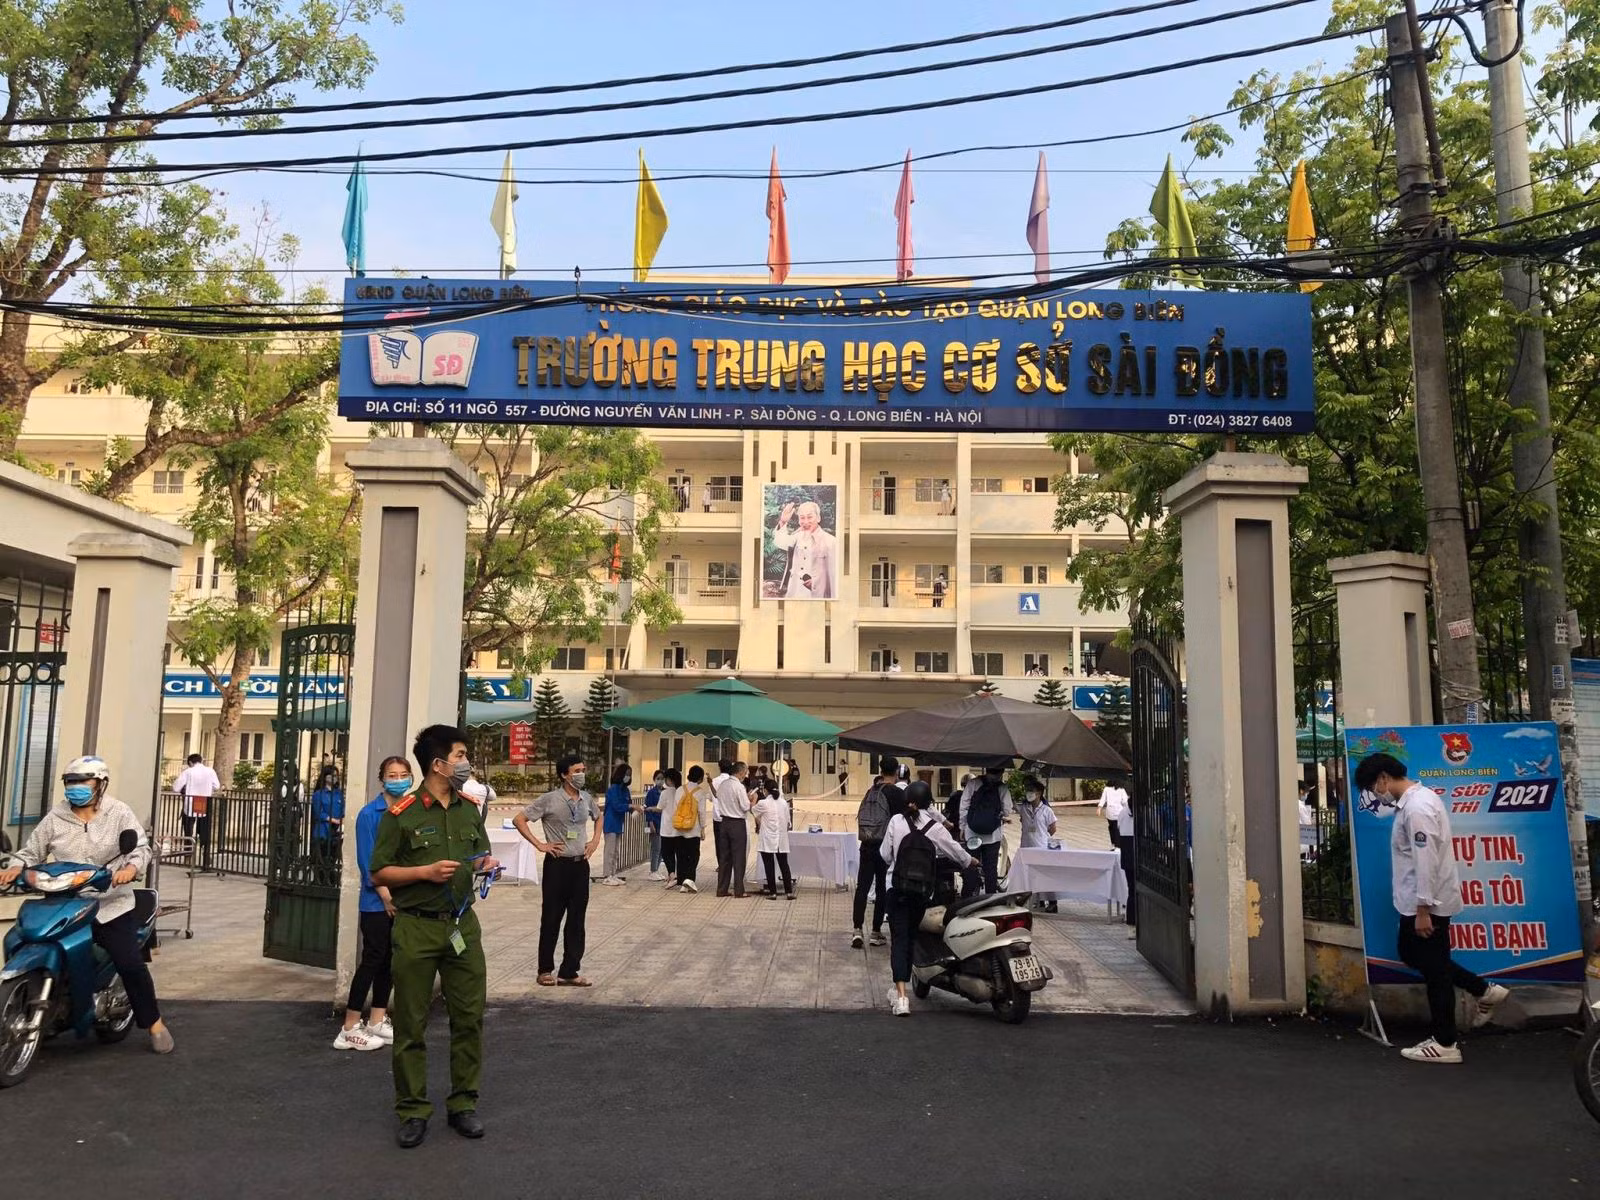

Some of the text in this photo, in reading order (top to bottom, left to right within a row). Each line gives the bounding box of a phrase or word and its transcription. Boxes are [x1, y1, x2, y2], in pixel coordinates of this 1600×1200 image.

[452, 286, 494, 300] LONG
[978, 295, 1049, 324] QUẬN
[1056, 300, 1125, 321] LONG
[1134, 298, 1185, 322] BIÊN
[512, 319, 1289, 402] TRƯỜNG TRUNG HỌC CƠ SỞ SÀI ĐỒNG
[366, 400, 389, 415] ĐỊA
[393, 399, 421, 413] CHỈ:
[424, 398, 446, 414] SỐ
[448, 403, 462, 415] 11
[466, 400, 498, 415] NGÕ
[505, 405, 528, 416] 557
[539, 402, 591, 417] ĐƯỜNG
[595, 402, 653, 418] NGUYỄN
[658, 406, 687, 419] VĂN
[690, 408, 722, 420] LINH
[734, 409, 745, 420] P.
[750, 405, 773, 420] SÀI
[776, 405, 817, 421] ĐỒNG
[890, 408, 923, 422] BIÊN
[934, 408, 953, 423] HÀ
[957, 409, 982, 425] NỘI
[1228, 415, 1258, 426] 3827
[1262, 416, 1293, 427] 6408
[1021, 595, 1038, 611] A
[1449, 768, 1475, 777] LONG
[1451, 782, 1493, 798] SỨC
[1496, 784, 1550, 807] 2021
[1452, 800, 1480, 813] THI
[1452, 835, 1476, 867] TỰ
[1480, 835, 1524, 864] TIN,
[1488, 874, 1524, 906] TÔI
[1492, 923, 1547, 955] BẠN!
